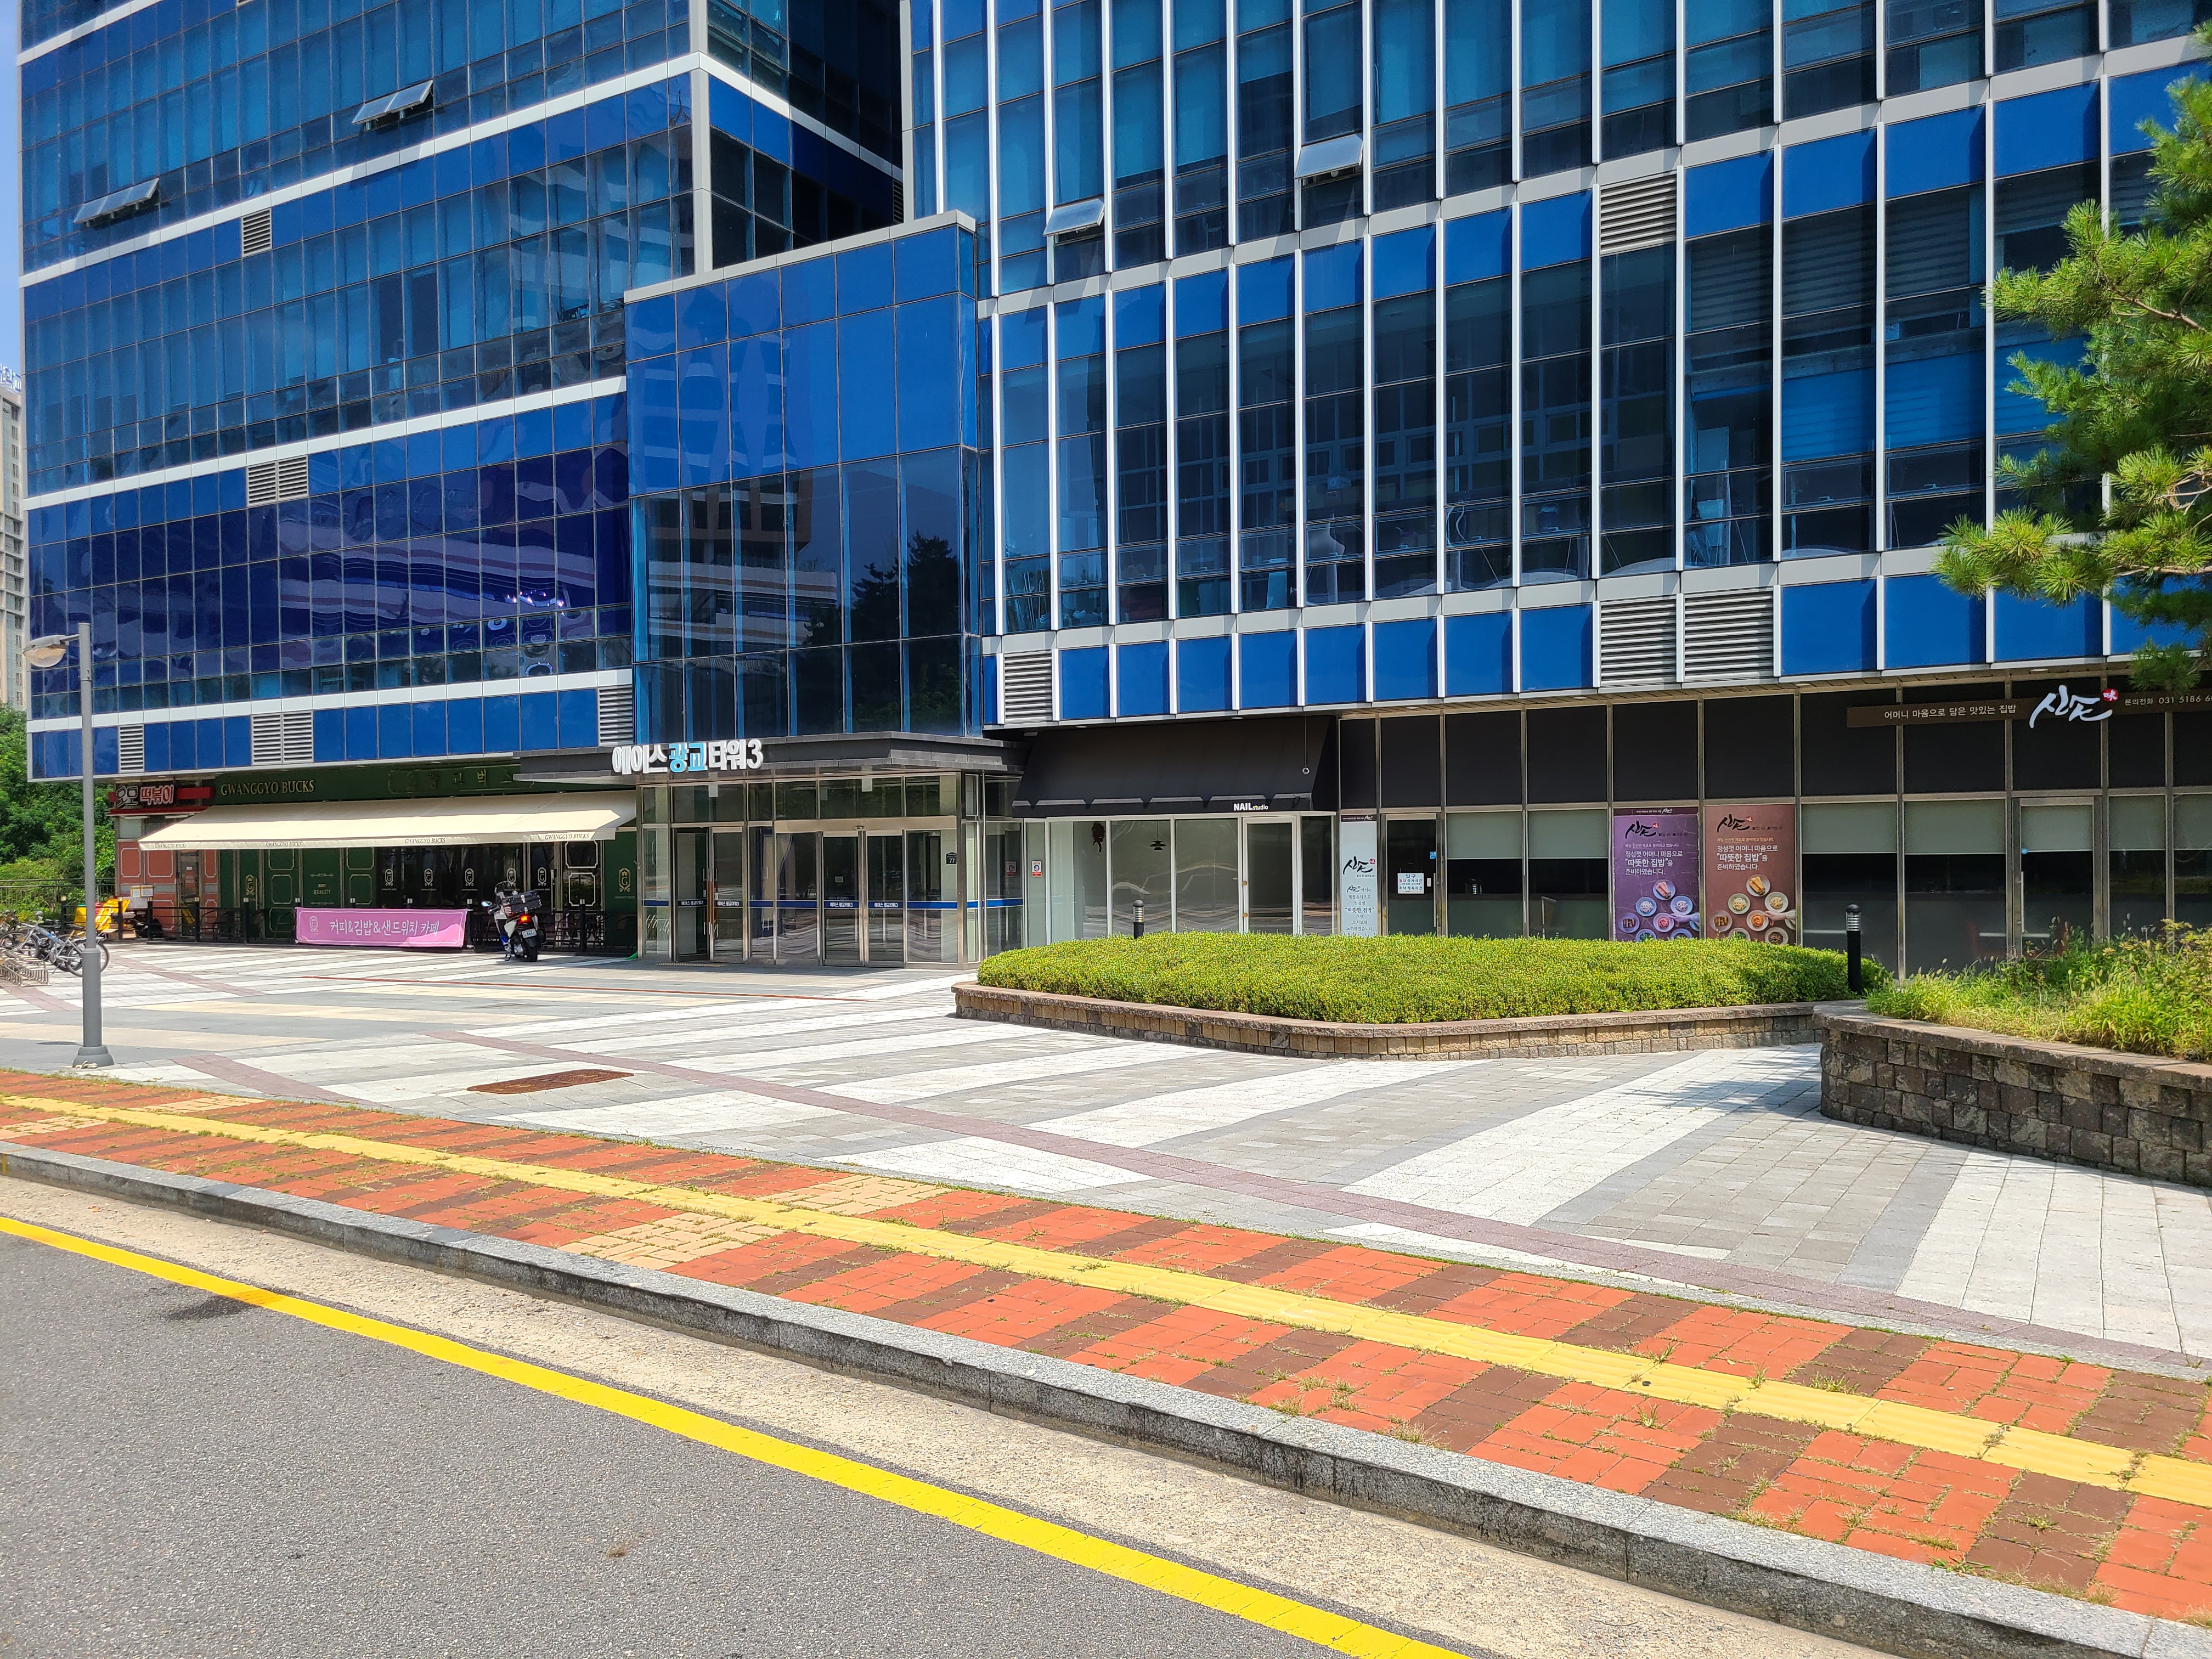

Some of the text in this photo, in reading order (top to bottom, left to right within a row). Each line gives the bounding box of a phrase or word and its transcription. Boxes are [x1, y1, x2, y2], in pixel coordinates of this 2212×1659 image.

[2125, 697, 2154, 706] 문의전화
[2179, 695, 2202, 703] 5186
[1884, 704, 2016, 719] 어머니 마음으로 담은 맛있는 집밥
[221, 780, 314, 796] GWANGGYO BUCKS
[330, 919, 439, 936] 커피&김밥&샌드위치 카페
